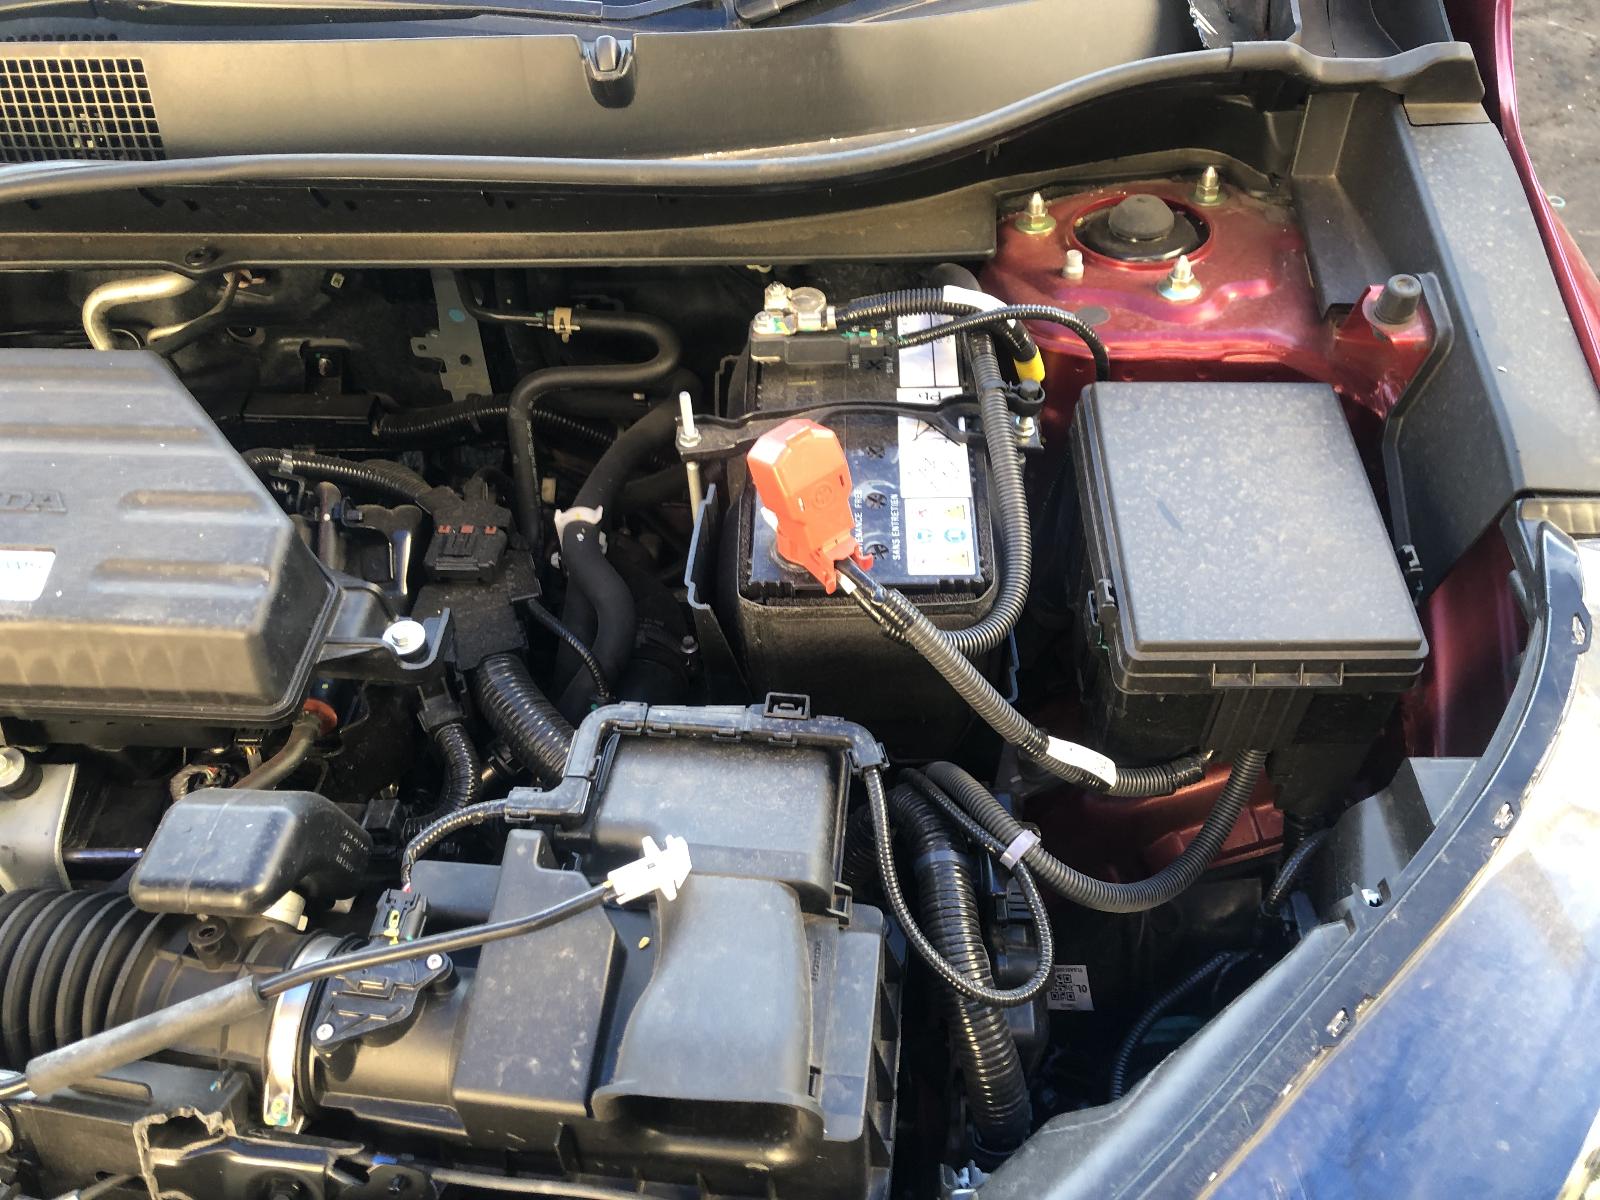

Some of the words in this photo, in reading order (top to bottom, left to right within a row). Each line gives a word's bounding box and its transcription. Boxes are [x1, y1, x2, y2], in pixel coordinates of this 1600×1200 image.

[854, 487, 862, 508] FREE
[890, 493, 900, 537] ENTRETIEN
[892, 538, 901, 561] SANS
